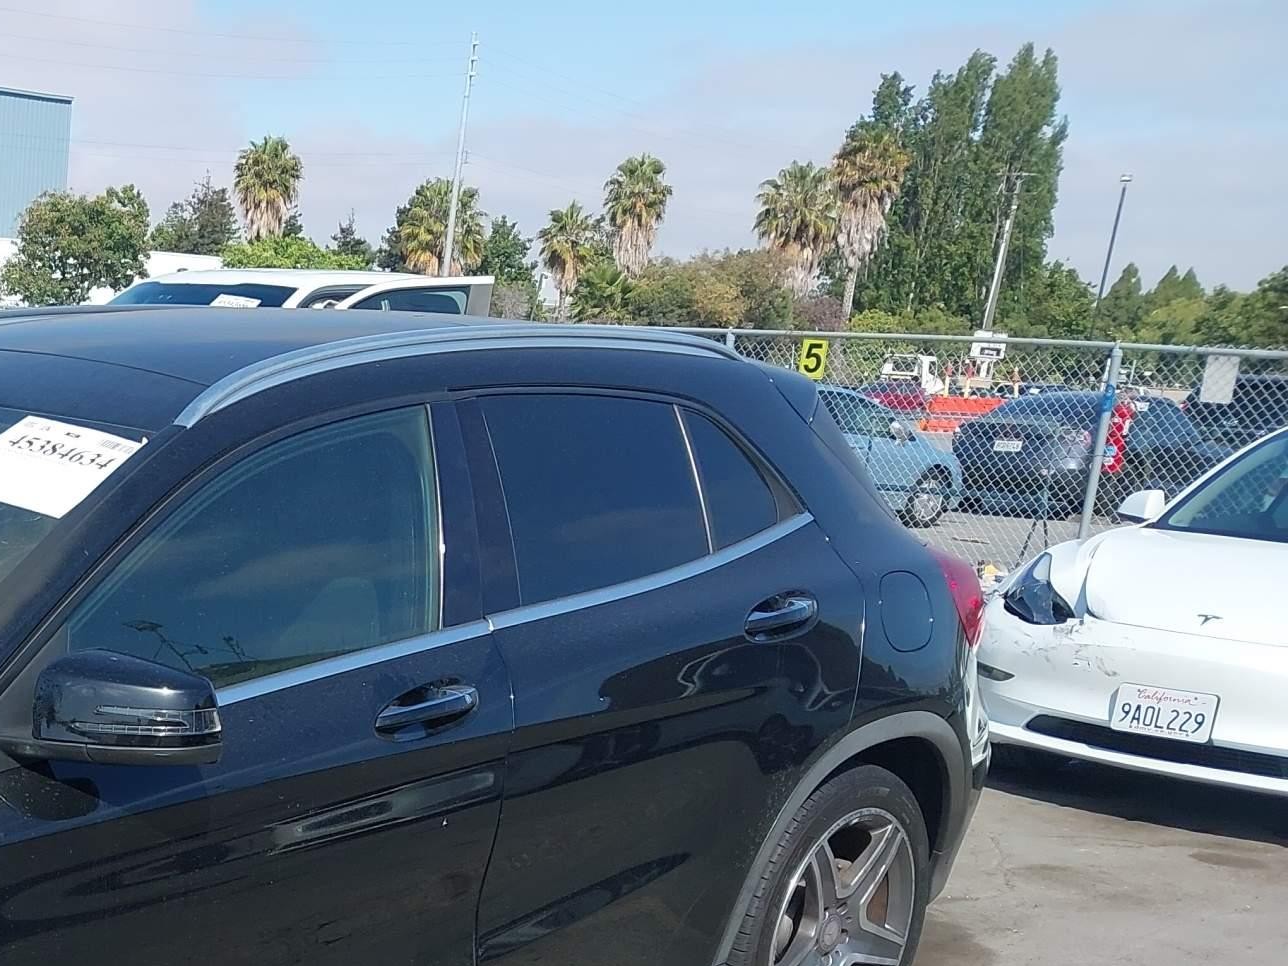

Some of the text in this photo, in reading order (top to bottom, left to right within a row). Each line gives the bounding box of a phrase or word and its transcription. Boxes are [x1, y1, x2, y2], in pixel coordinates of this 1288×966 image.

[803, 343, 824, 373] 5
[9, 434, 117, 470] 45384634
[1137, 688, 1201, 706] California
[1118, 702, 1206, 734] 9AOL229
